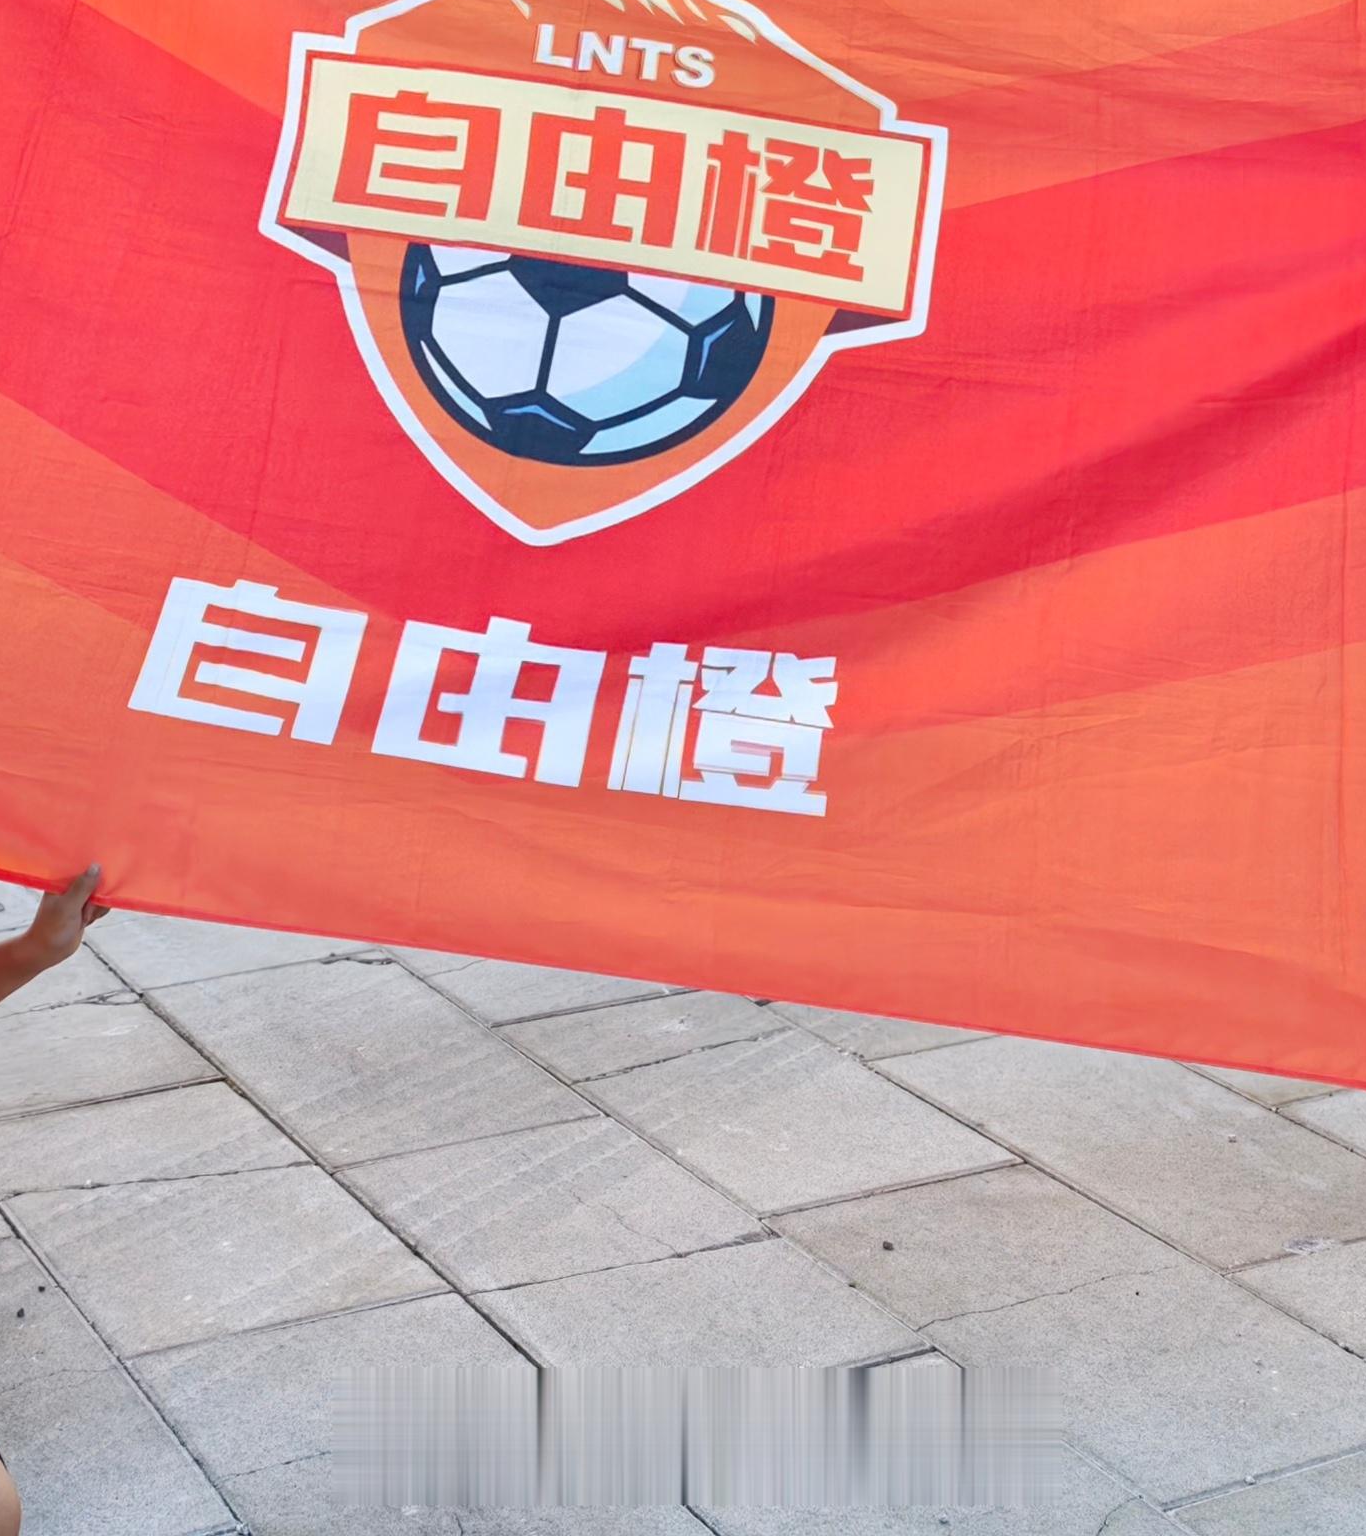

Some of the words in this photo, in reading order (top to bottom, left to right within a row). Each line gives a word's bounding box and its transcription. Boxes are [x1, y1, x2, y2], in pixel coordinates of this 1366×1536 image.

[534, 23, 716, 89] LNTS
[332, 89, 875, 280] 自由橙
[127, 575, 838, 817] 自由橙
